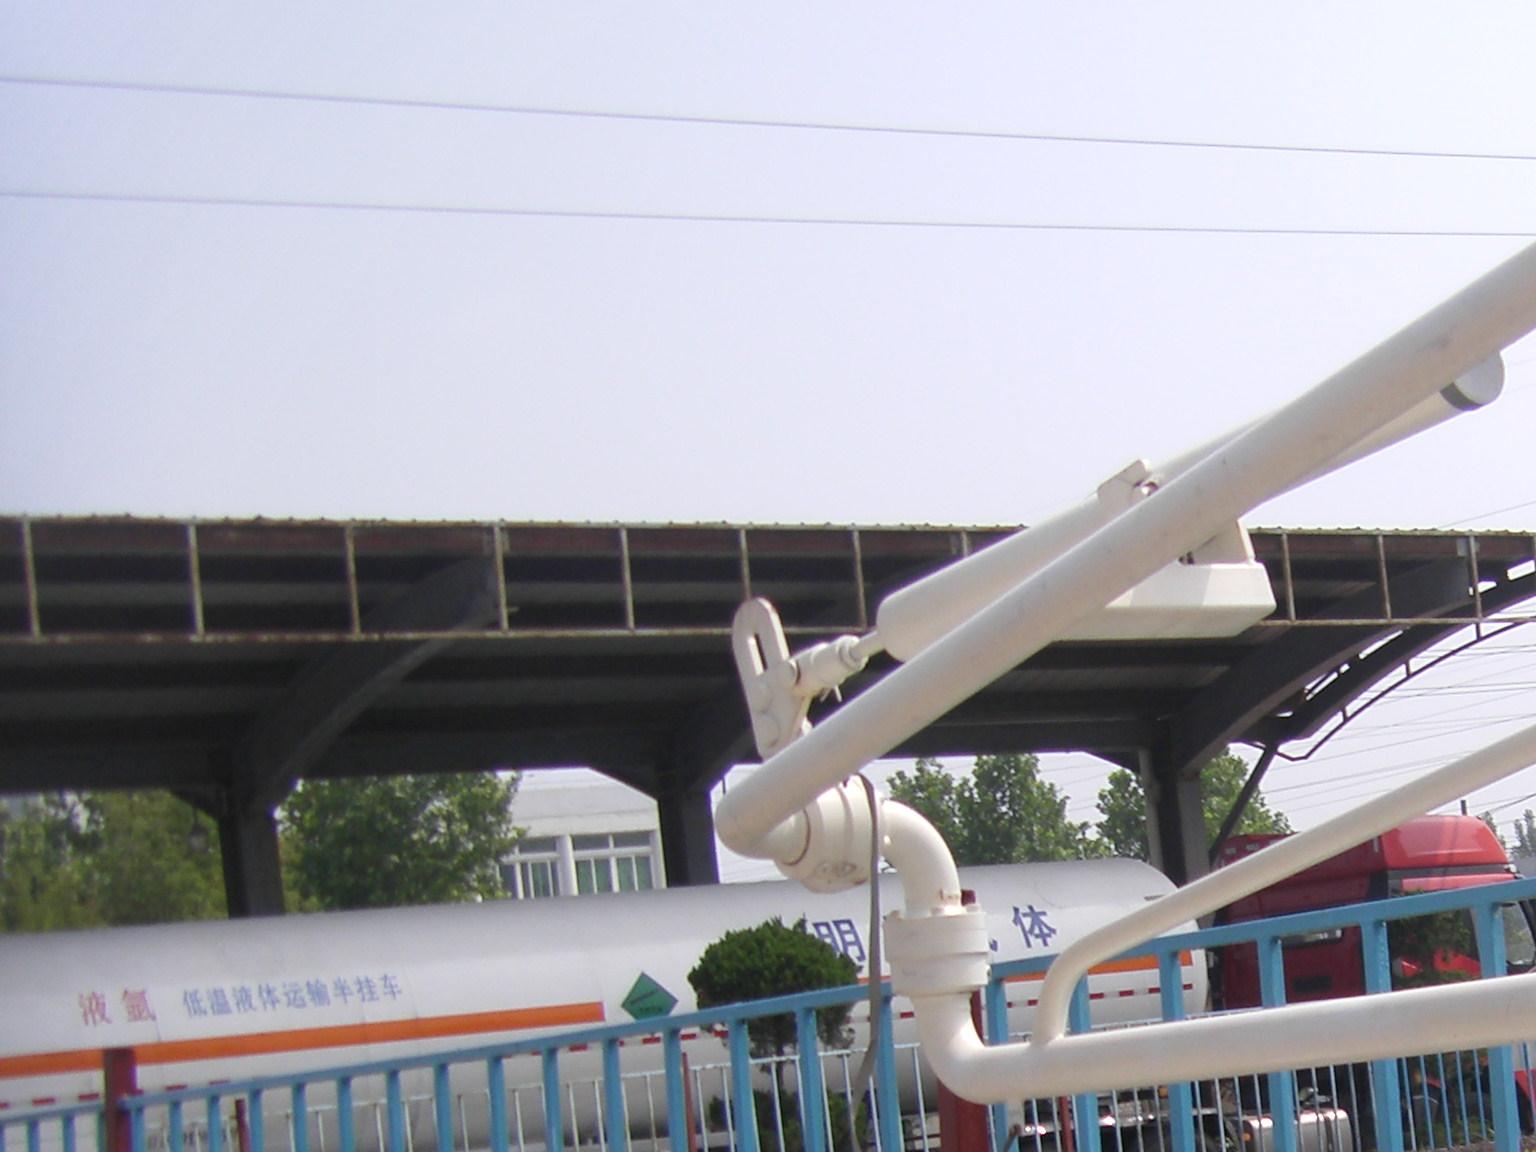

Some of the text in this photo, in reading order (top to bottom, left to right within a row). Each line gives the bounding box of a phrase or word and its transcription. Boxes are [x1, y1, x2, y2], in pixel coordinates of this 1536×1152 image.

[182, 973, 402, 1018] 低温液体运输半挂车
